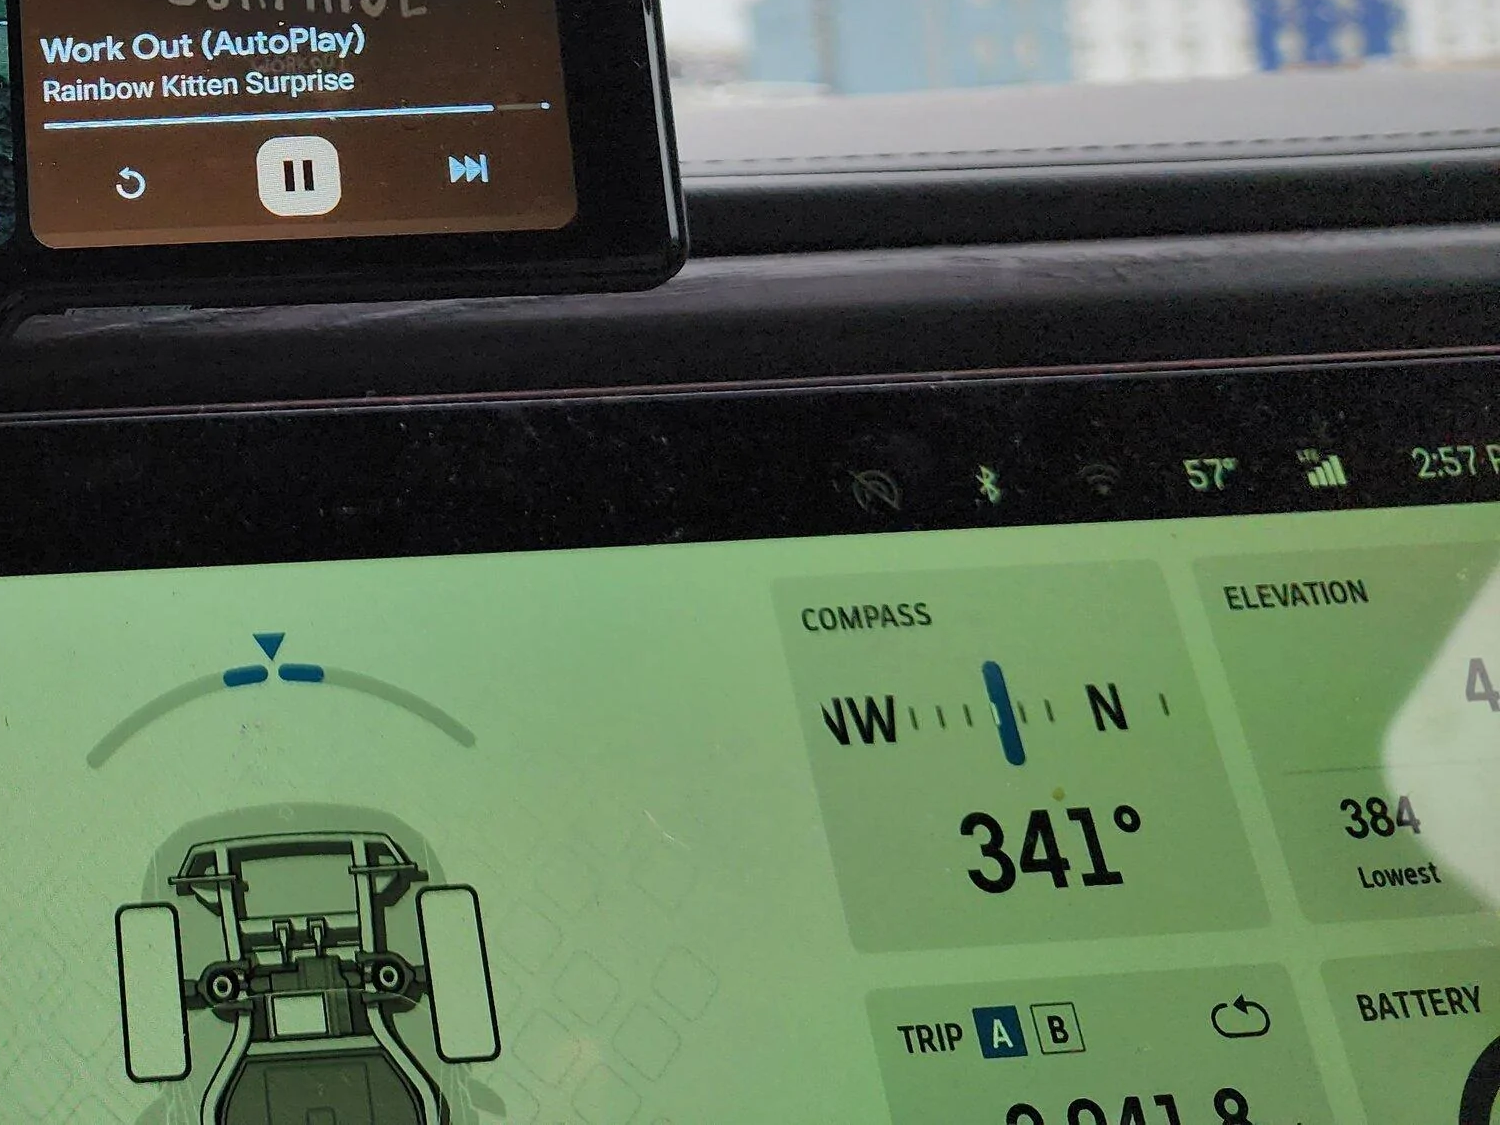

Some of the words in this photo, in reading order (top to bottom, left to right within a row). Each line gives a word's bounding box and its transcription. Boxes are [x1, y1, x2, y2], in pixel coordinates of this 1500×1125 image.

[39, 35, 126, 63] Work
[131, 32, 193, 60] Out
[201, 23, 365, 60] (AutoPlay)
[42, 77, 154, 103] Rainbow
[161, 74, 239, 98] Kitten
[246, 69, 355, 98] Surprise
[1182, 457, 1238, 491] 57°
[1411, 444, 1478, 479] 2:57
[1222, 578, 1369, 612] ELEVATION
[801, 602, 932, 632] COMPASS
[1084, 682, 1130, 733] N
[1339, 795, 1421, 840] 384
[958, 804, 1142, 895] 341°
[1357, 861, 1443, 889] Lowest
[1355, 985, 1483, 1023] BATTERY
[897, 1022, 963, 1055] TRIP
[991, 1017, 1015, 1050] A
[1046, 1014, 1070, 1045] B
